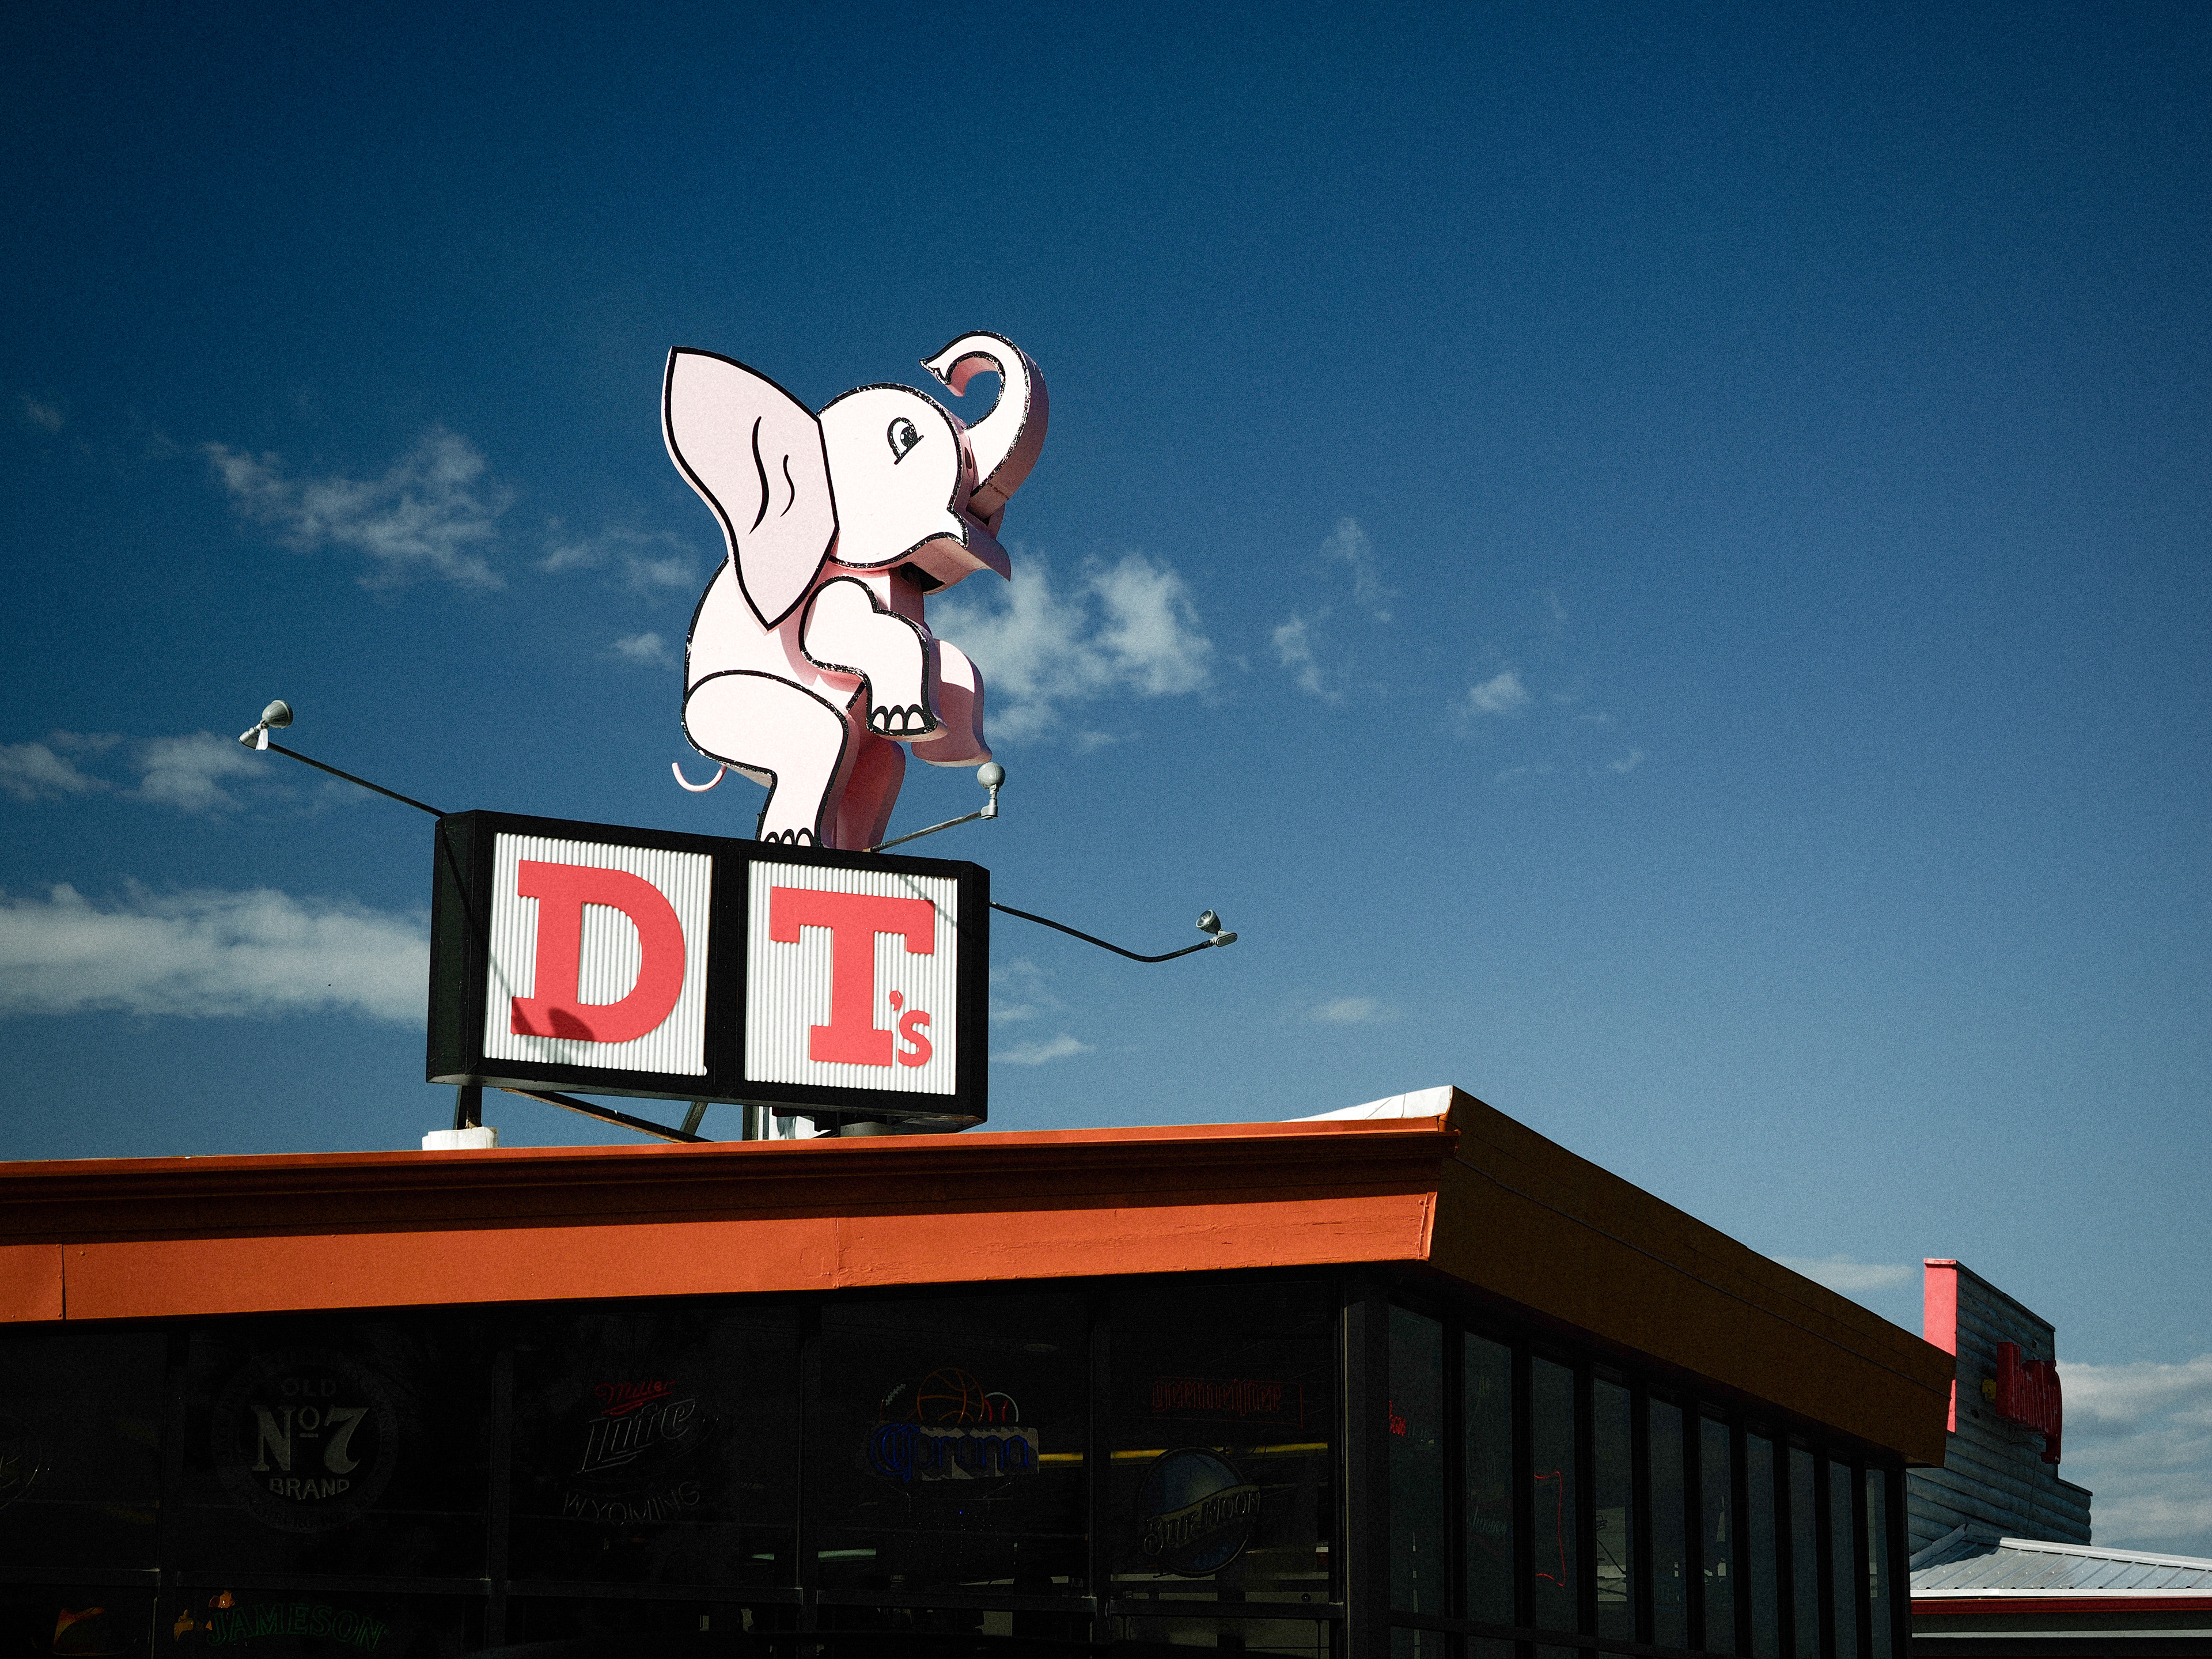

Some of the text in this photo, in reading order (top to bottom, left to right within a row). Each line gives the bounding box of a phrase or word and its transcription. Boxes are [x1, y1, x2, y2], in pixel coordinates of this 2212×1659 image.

[281, 1378, 337, 1397] OLD
[594, 1379, 676, 1406] Miller
[870, 1422, 1031, 1482] Corona
[269, 1478, 350, 1501] BRAND
[562, 1482, 700, 1526] WYOMING
[1201, 1491, 1262, 1528] MOON
[206, 1602, 386, 1653] JAMESON
